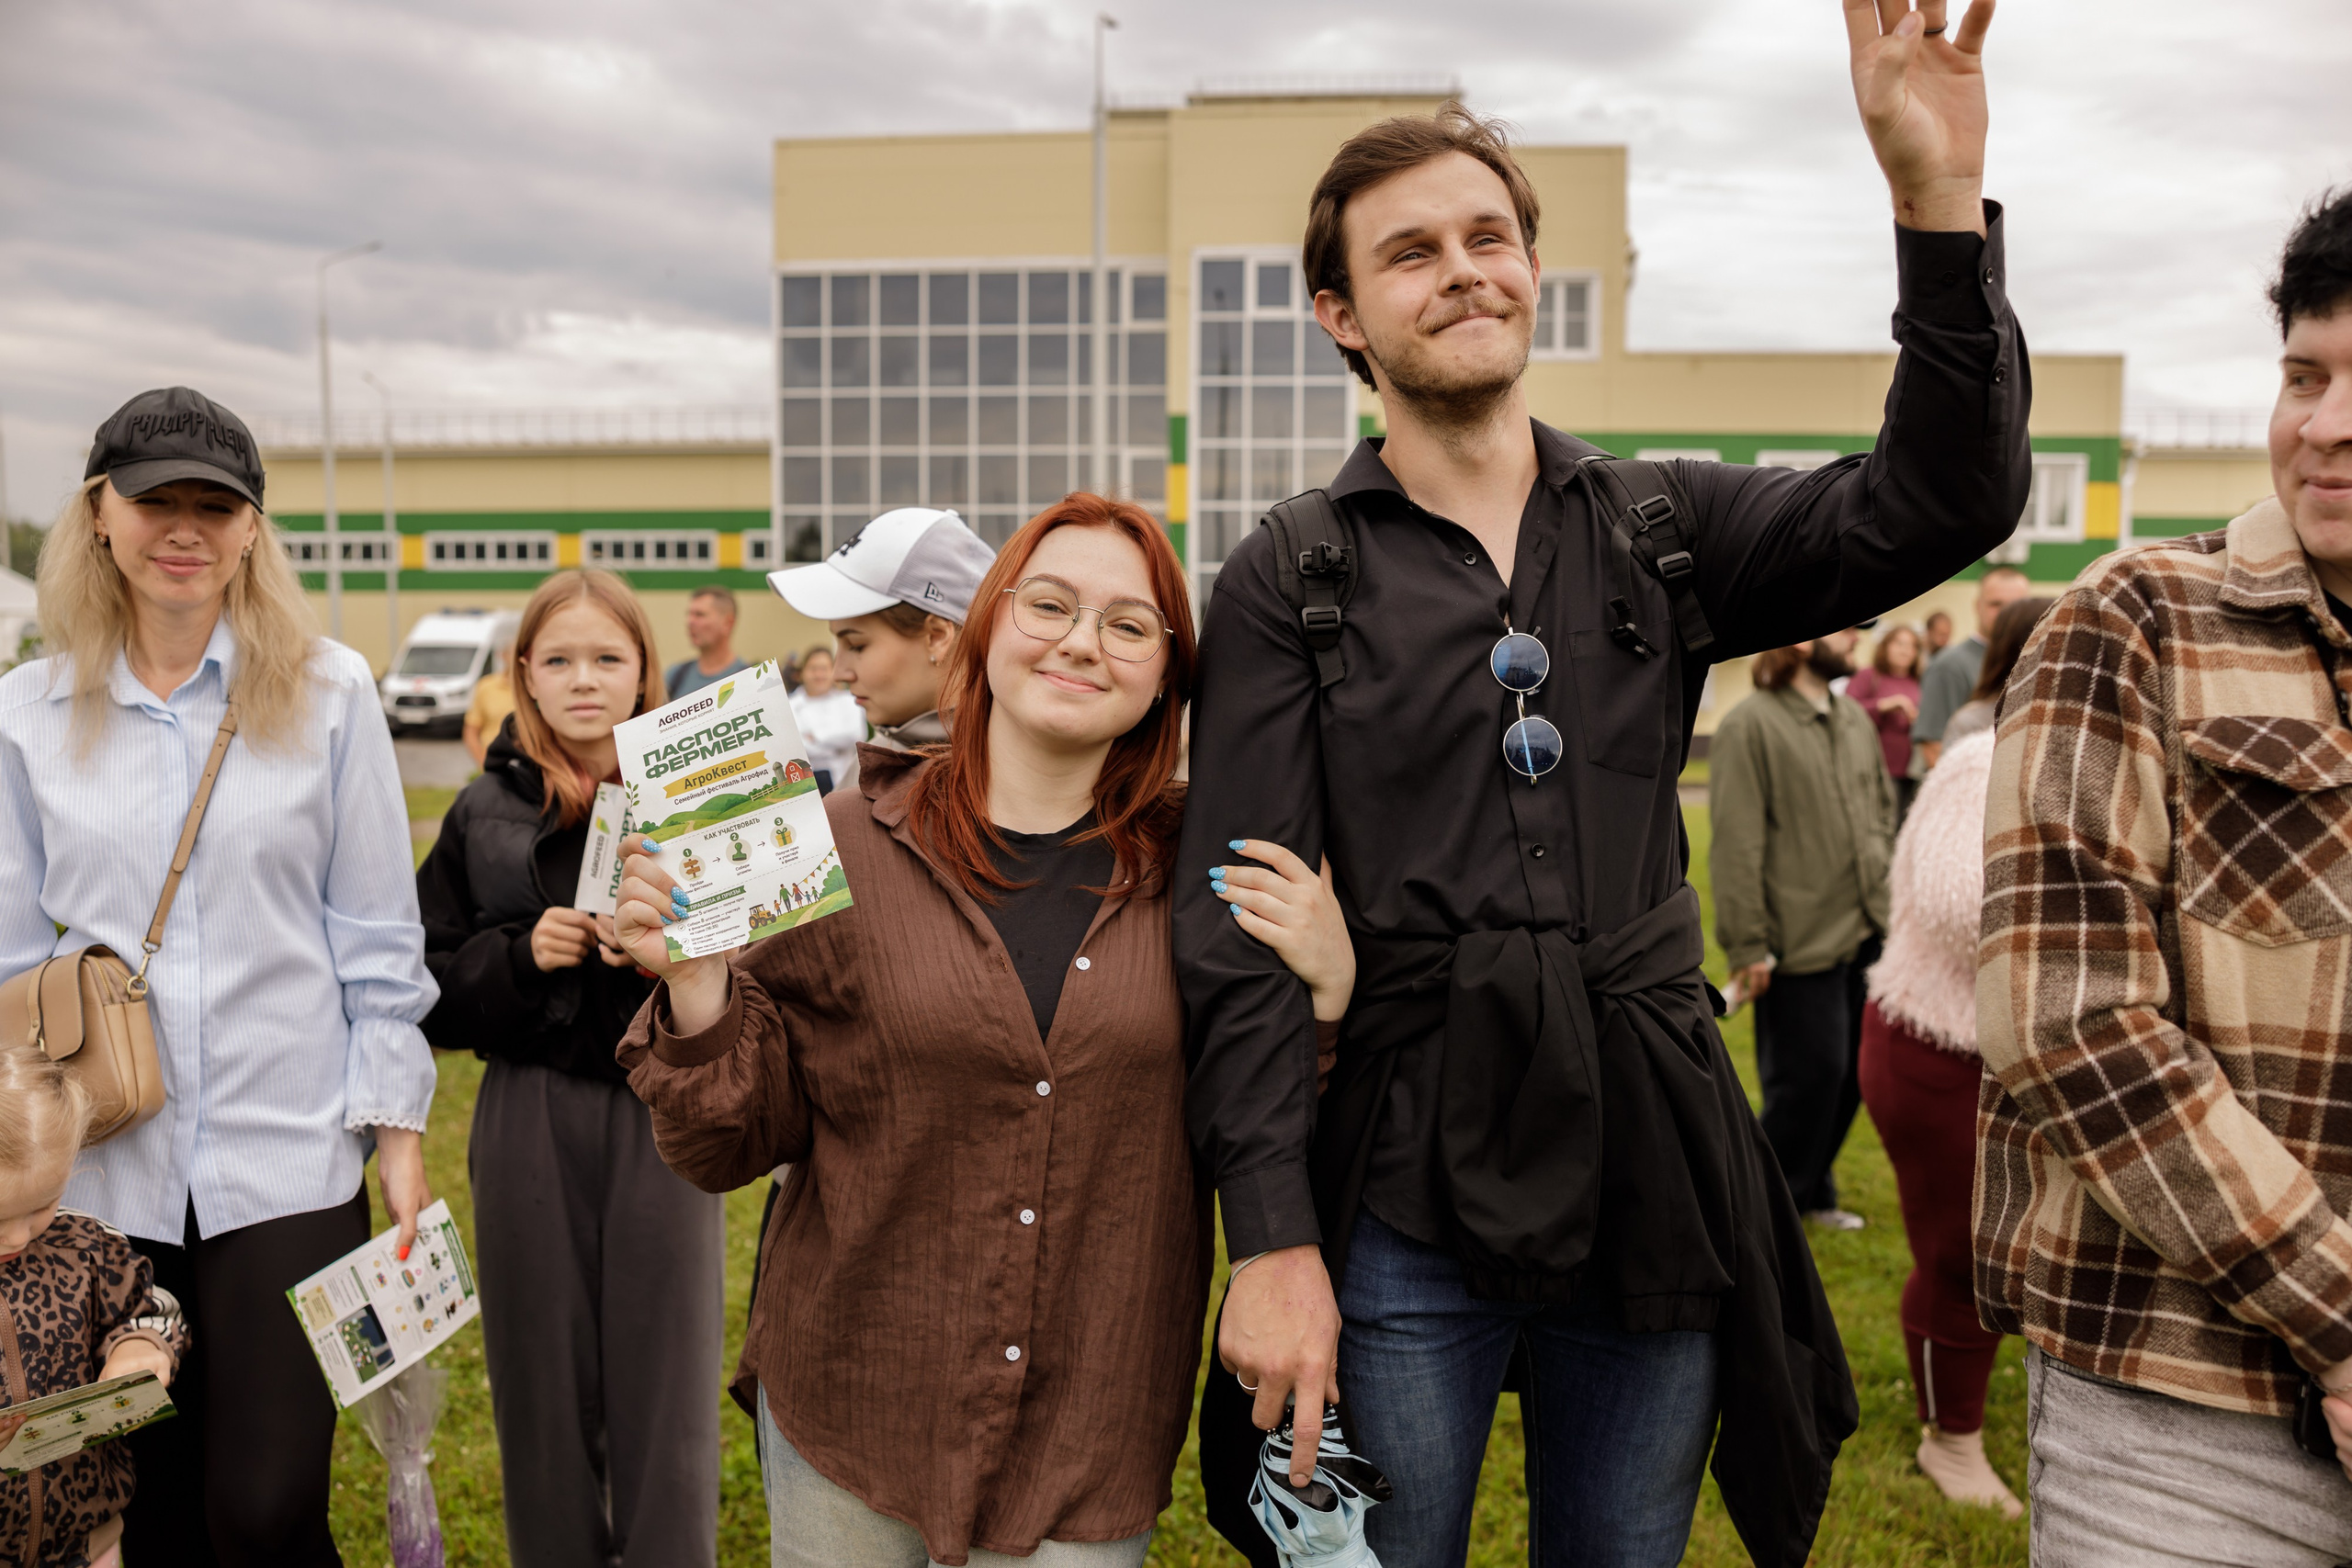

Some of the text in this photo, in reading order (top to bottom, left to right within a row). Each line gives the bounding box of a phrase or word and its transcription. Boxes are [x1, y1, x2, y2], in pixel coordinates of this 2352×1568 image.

[659, 698, 713, 728] AGROFEED
[643, 708, 763, 766] ПАСПОРТ
[646, 725, 773, 779] ФЕРМЕРА
[674, 769, 769, 806] Семейный фестиваль Агрофид
[684, 760, 747, 790] АгроКвест
[704, 818, 760, 840] КАК УЧАСТВОВАТЬ
[608, 807, 632, 897] ПАСОРТ
[690, 897, 716, 910] ПРАВИЛА
[722, 888, 741, 899] ПРИЗЫ
